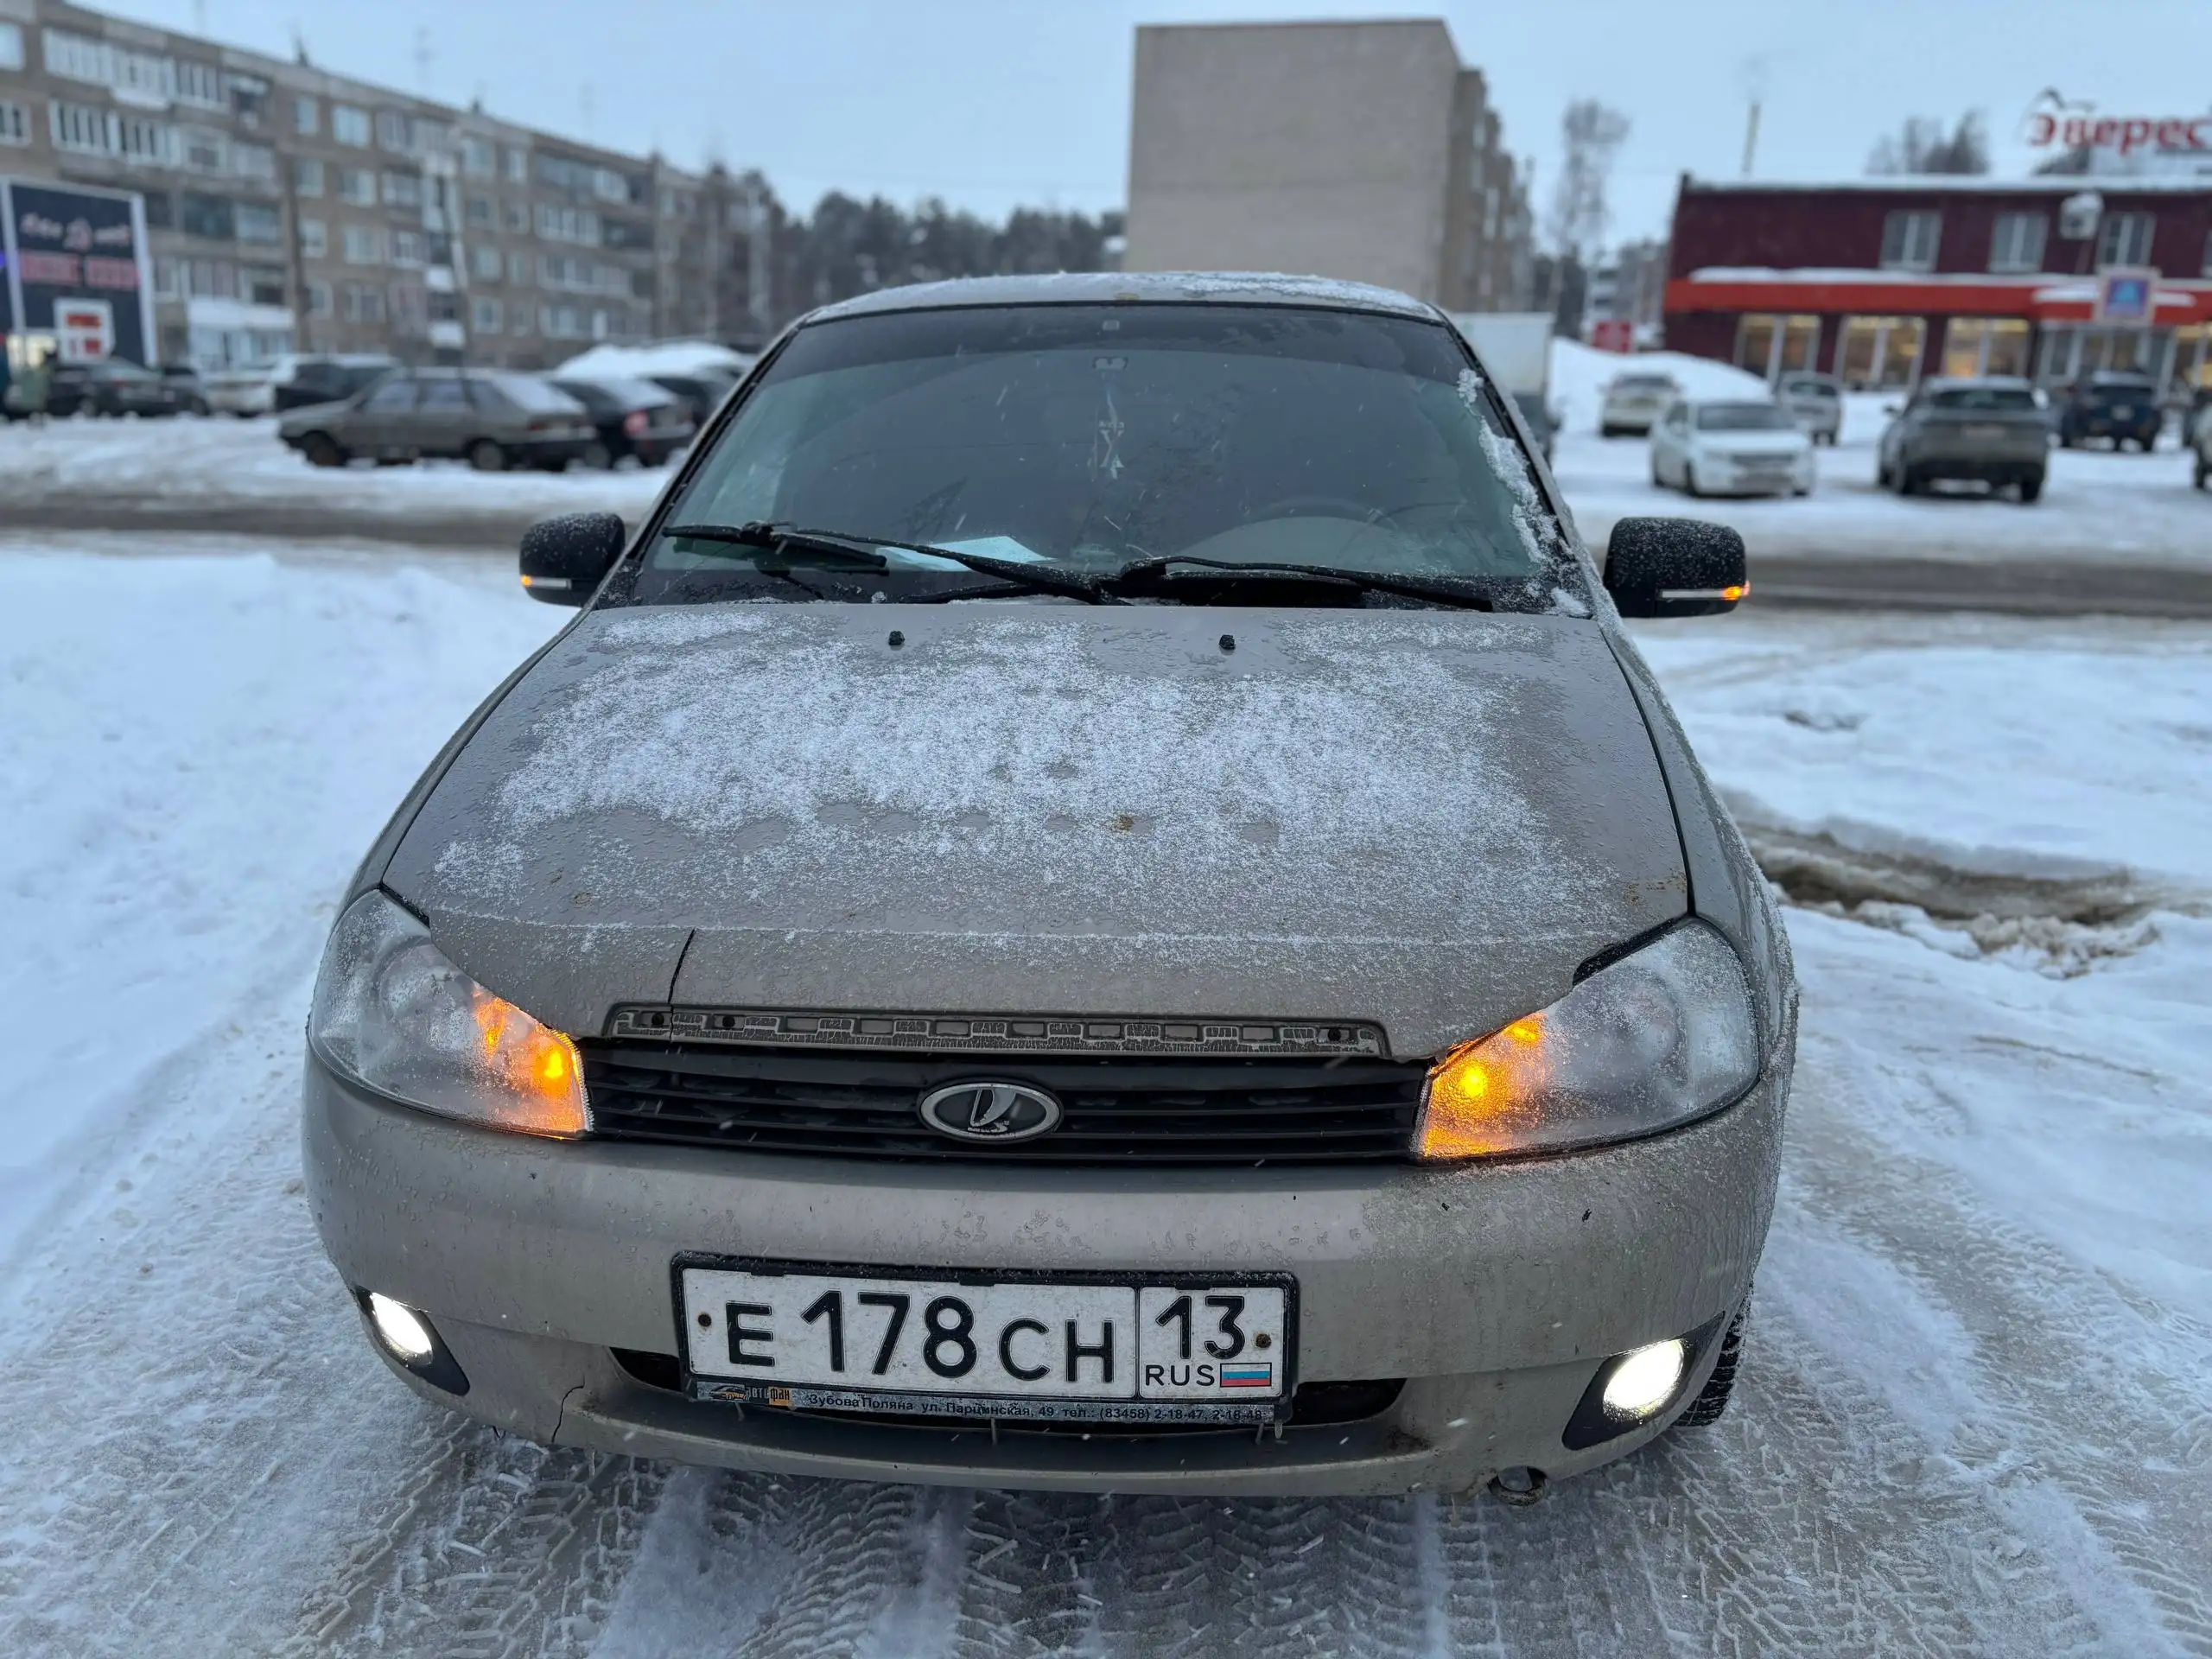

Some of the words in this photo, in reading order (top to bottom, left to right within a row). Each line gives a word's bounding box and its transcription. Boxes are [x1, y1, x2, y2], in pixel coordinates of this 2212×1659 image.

[1155, 1295, 1246, 1359] 13
[1145, 1364, 1215, 1386] RUS
[810, 1393, 860, 1408] Зубова
[862, 1397, 914, 1410] Поляна
[921, 1403, 941, 1413] ул.
[1039, 1406, 1054, 1416] 49
[1099, 1408, 1150, 1420] (83458)
